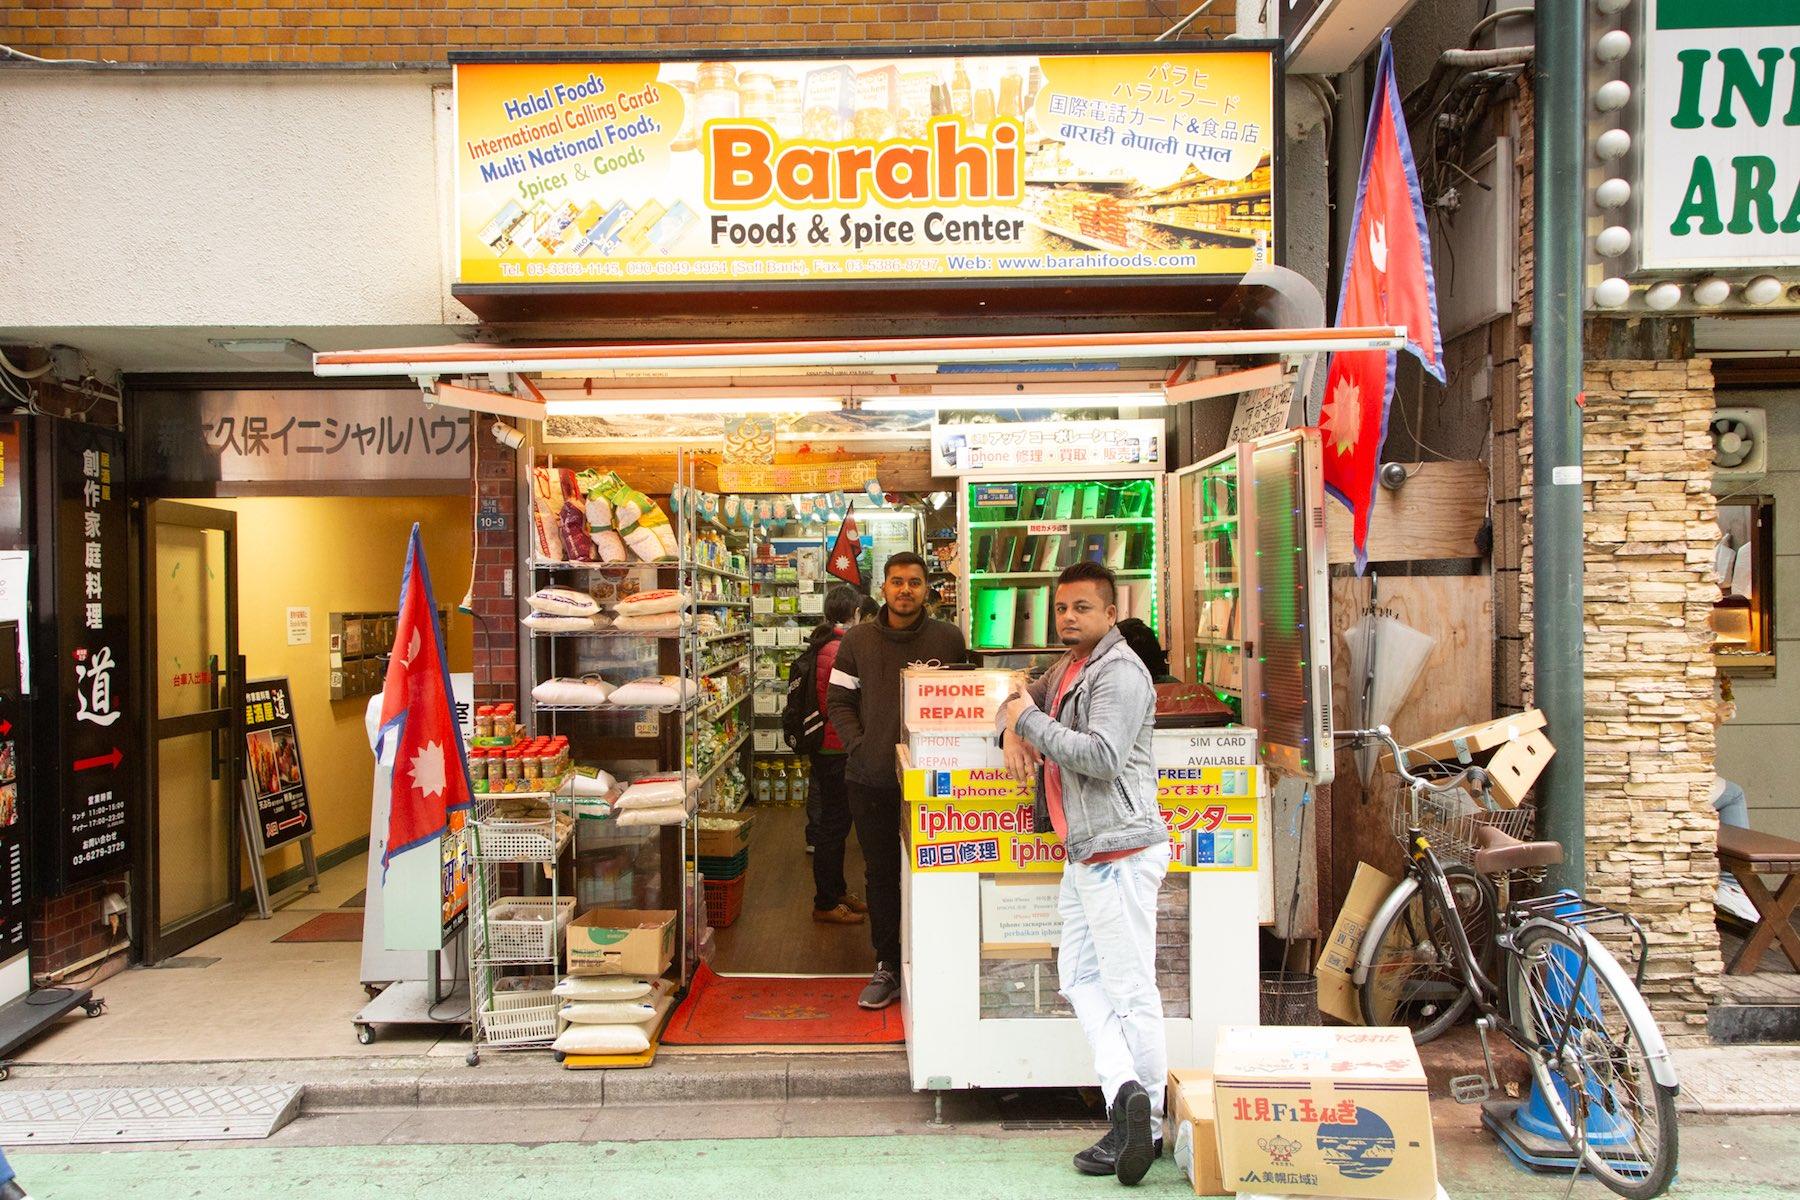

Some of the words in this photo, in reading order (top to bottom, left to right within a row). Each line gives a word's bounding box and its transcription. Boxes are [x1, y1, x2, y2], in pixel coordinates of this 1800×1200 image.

[1149, 63, 1208, 89] バラヒ
[1670, 47, 1800, 130] IN
[504, 90, 554, 120] Halal
[555, 75, 605, 104] Foods
[1113, 84, 1239, 114] ハラルフード
[467, 115, 564, 160] International
[565, 102, 617, 129] Calling
[618, 85, 660, 112] Cards
[1049, 94, 1260, 144] 国際電話カード&食品店
[480, 154, 527, 183] Multi
[528, 130, 604, 169] National
[604, 114, 661, 145] Foods,
[1060, 121, 1115, 145] बाराही
[1121, 129, 1180, 155] नेपाली
[1185, 142, 1232, 163] पसल
[518, 170, 568, 201] Spices
[575, 163, 590, 181] &
[594, 145, 646, 175] Goods
[711, 123, 1016, 202] Barahi
[710, 214, 796, 245] Foods
[807, 214, 831, 244] &
[839, 213, 914, 249] Spice
[923, 212, 1025, 243] Center
[501, 263, 523, 276] Tel.
[731, 261, 764, 275] (Soft
[814, 260, 843, 273] Fax.
[947, 256, 992, 271] Web:
[998, 253, 1197, 269] www.barahifoods.com
[480, 517, 505, 527] 10-9
[83, 449, 103, 630] 創作家庭料理
[75, 646, 121, 726] 道
[918, 684, 985, 697] iPHONE
[920, 708, 985, 719] REPAIR
[636, 725, 658, 733] OPEN
[1190, 737, 1211, 747] SIM
[1216, 737, 1246, 747] CARD
[918, 757, 959, 767] REPAIR
[1157, 768, 1202, 779] FREE!
[1187, 756, 1246, 766] AVAILABLE
[952, 785, 1035, 799] iphone・ス
[1158, 804, 1252, 832] センター
[73, 841, 126, 865] 03-6279-3729
[919, 842, 998, 866] 即日修理
[1233, 1097, 1358, 1125] 北見F1玉ねぎ
